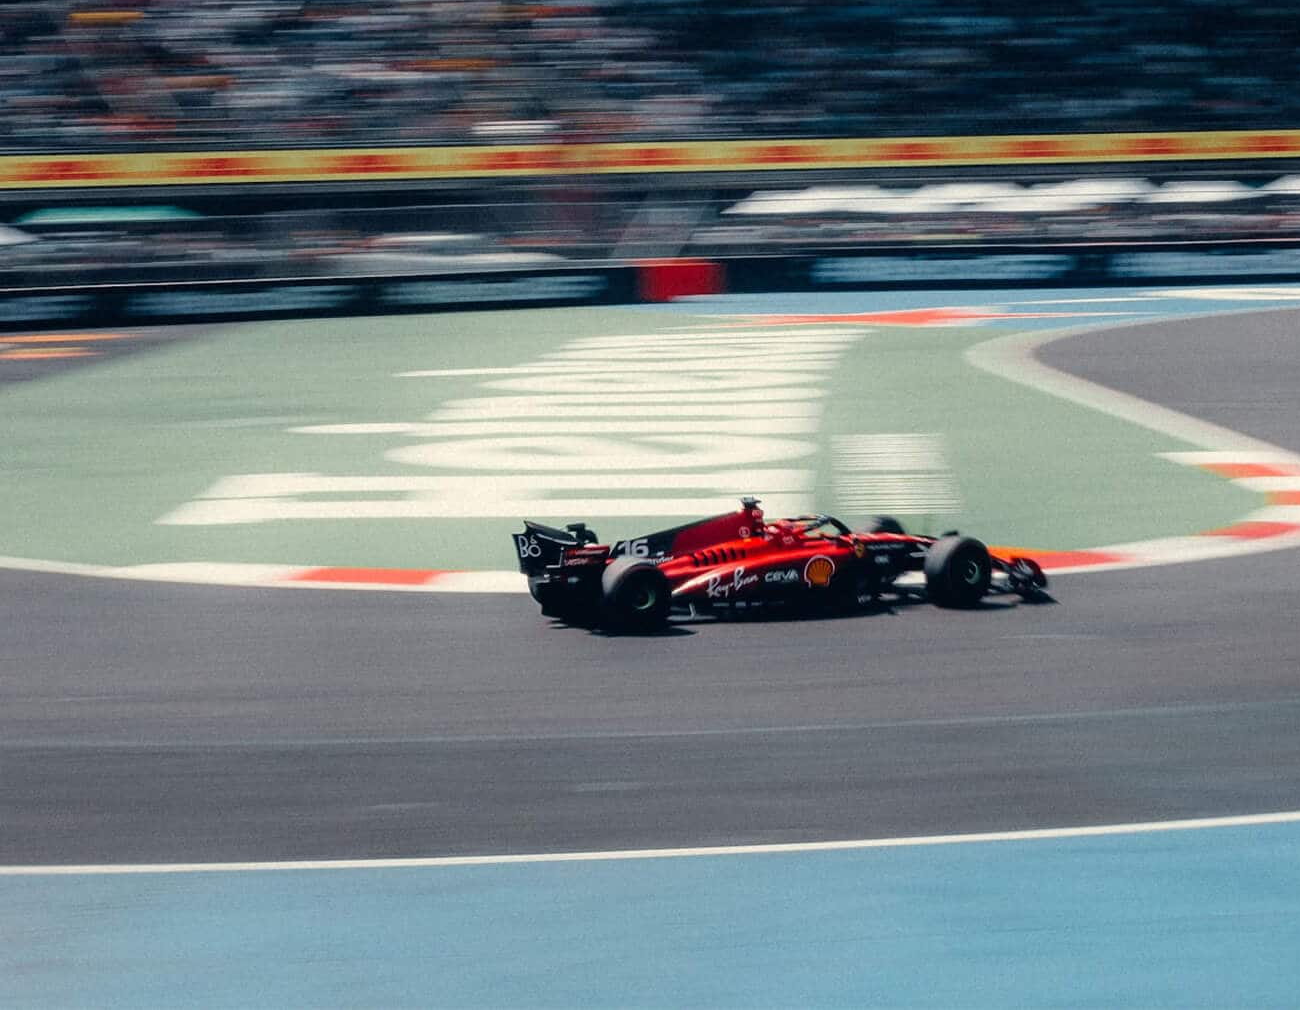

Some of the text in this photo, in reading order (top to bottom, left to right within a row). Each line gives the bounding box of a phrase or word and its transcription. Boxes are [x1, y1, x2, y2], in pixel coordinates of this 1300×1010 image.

[617, 539, 649, 558] 16
[707, 566, 759, 598] Ray-Ban
[764, 569, 799, 583] CEVA
